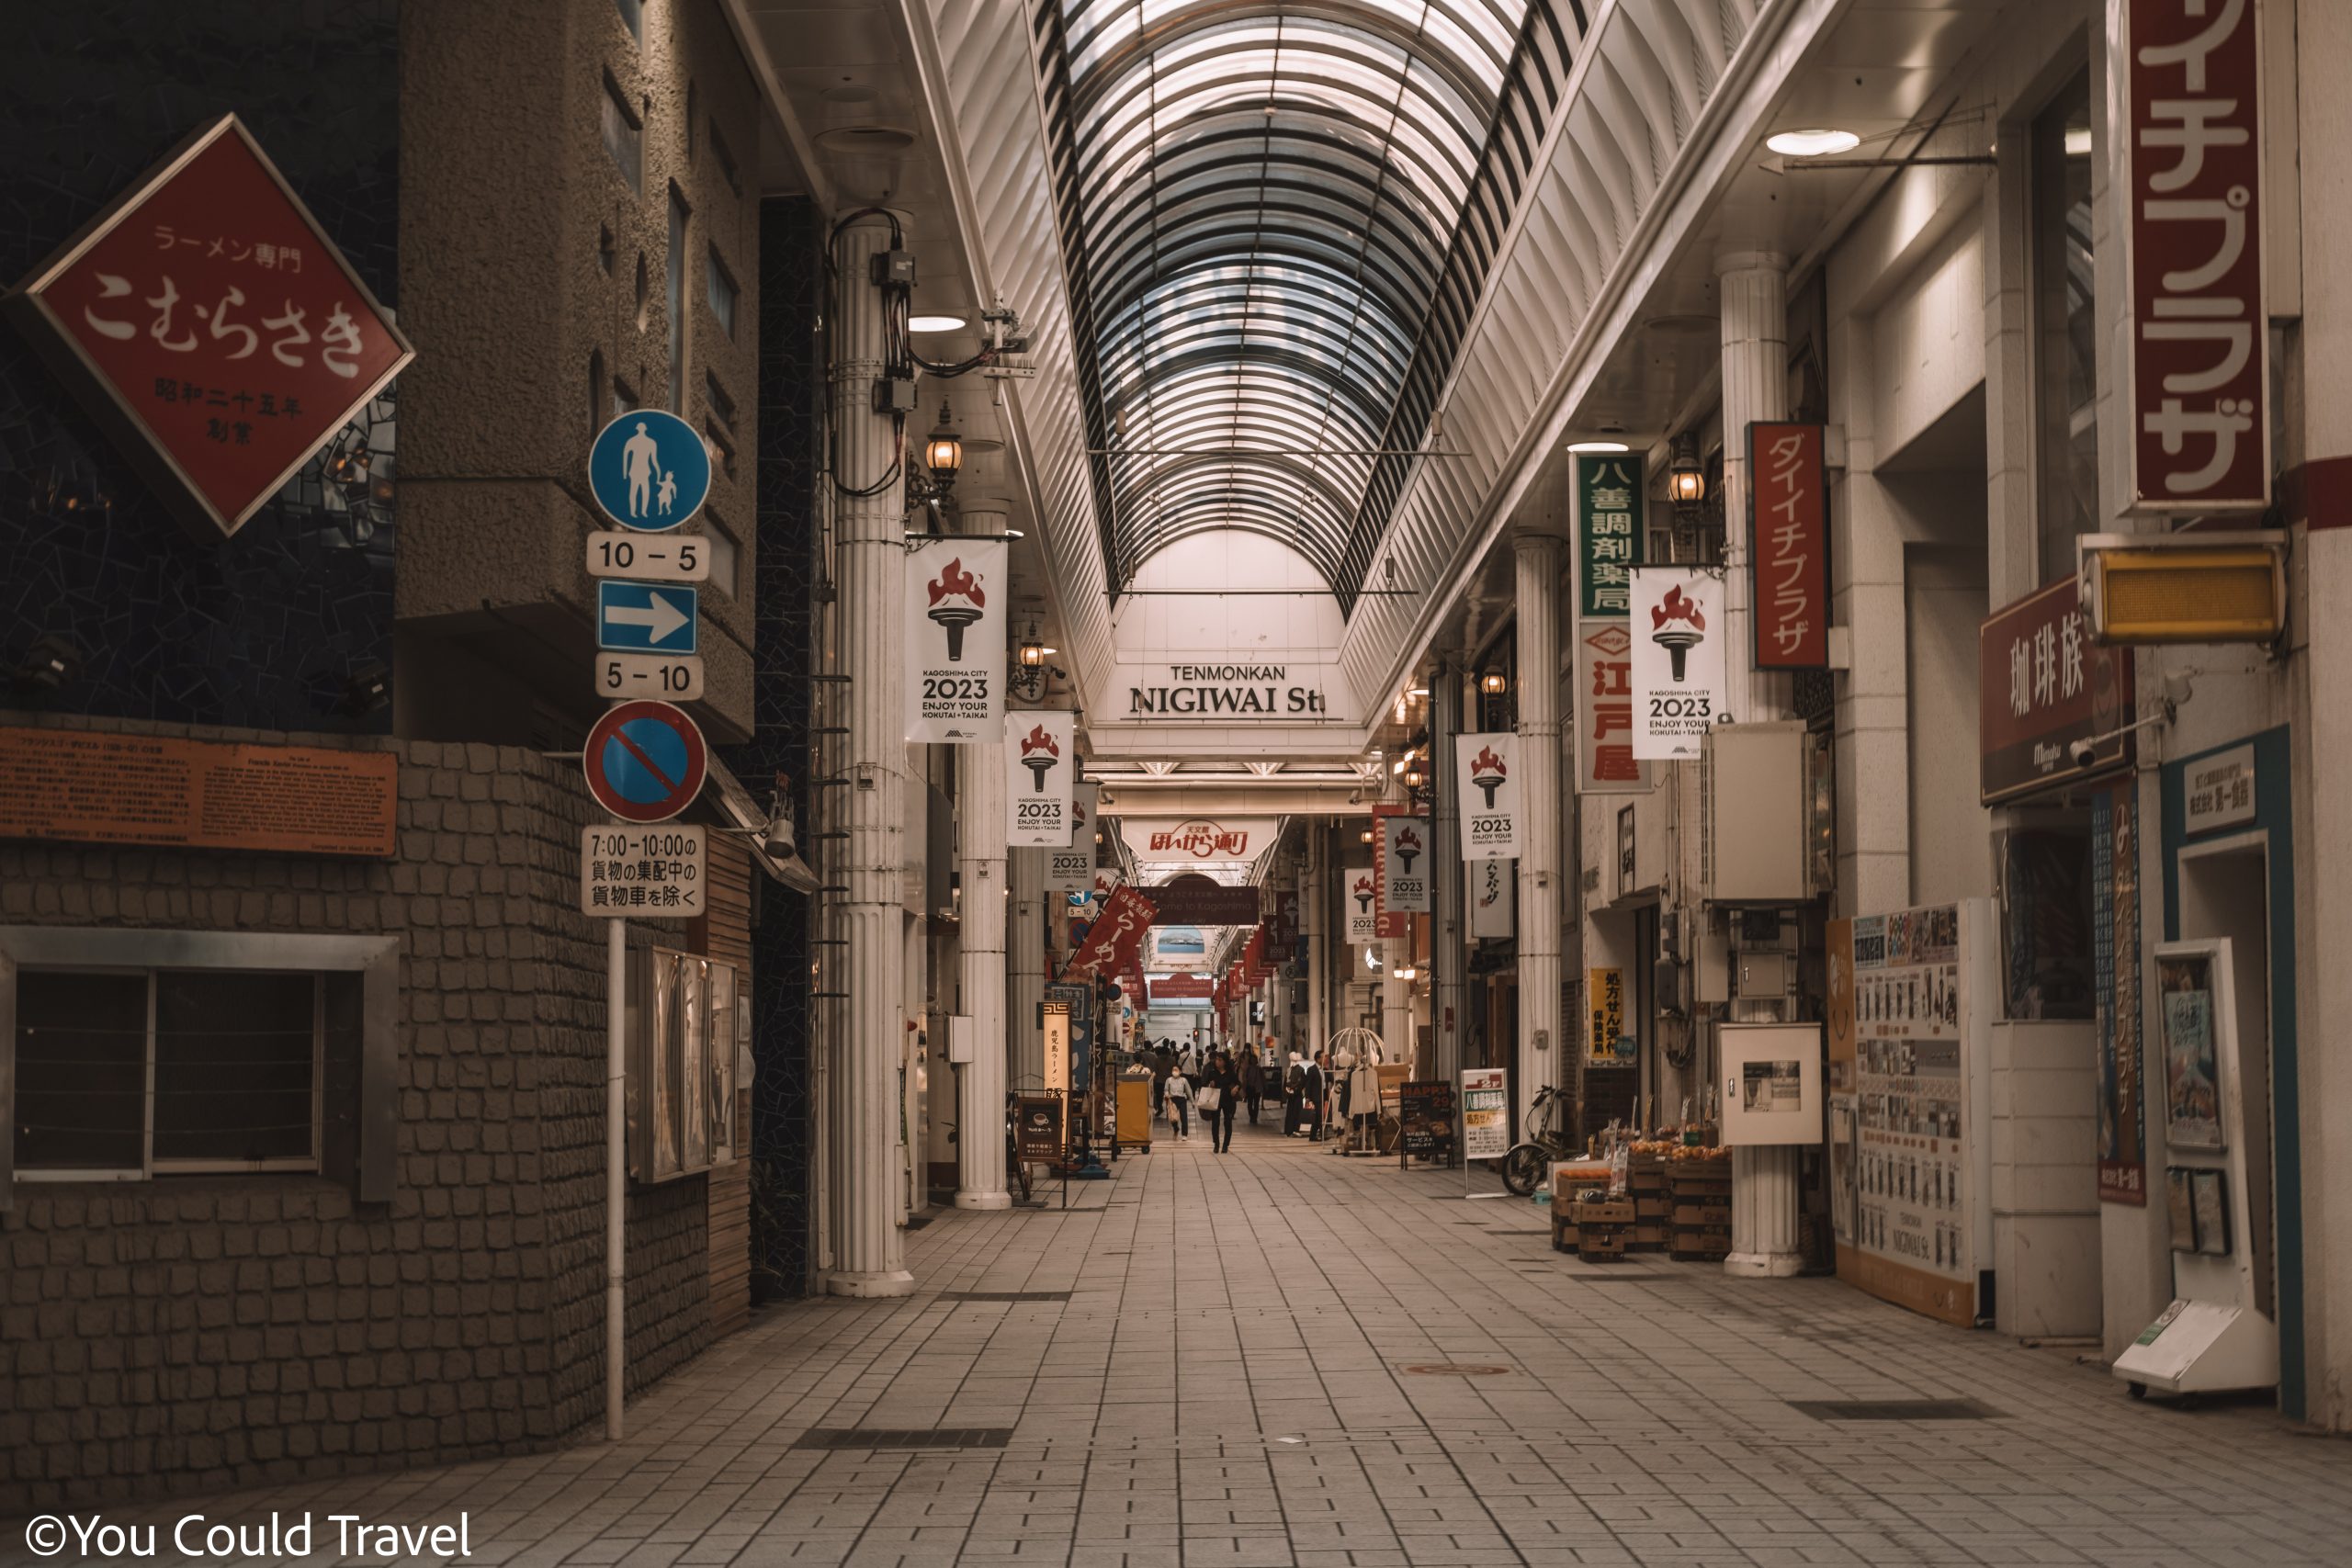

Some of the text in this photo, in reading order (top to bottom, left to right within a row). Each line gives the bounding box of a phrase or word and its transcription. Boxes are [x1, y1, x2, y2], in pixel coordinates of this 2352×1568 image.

[154, 225, 301, 274] ラーメン専門
[85, 272, 364, 379] こむらさき
[154, 378, 303, 420] 昭和二十五年
[206, 418, 254, 446] 創業
[1590, 462, 1633, 611] 八善調剤薬局
[1769, 433, 1809, 656] ダイイチプラザ
[599, 541, 634, 569] 10
[679, 545, 696, 571] 5
[607, 662, 622, 688] 5
[660, 665, 690, 692] 10
[1170, 666, 1285, 681] TENMONKAN
[2009, 611, 2084, 719] 珈琲族
[922, 679, 988, 699] 2023
[1129, 687, 1277, 713] NIGIWAI
[922, 702, 988, 710] ENJOY YOUR
[1650, 698, 1711, 716] 2023
[1593, 660, 1640, 781] 江戸屋
[1018, 804, 1061, 818] 2023
[1472, 819, 1512, 833] 2023
[1149, 832, 1249, 857] はいから通り
[592, 860, 696, 882] 貨物の集配中の
[1053, 858, 1088, 868] 2023
[592, 886, 695, 908] 貨物車を除く
[1393, 882, 1423, 892] 2023
[1605, 972, 1621, 1054] 処方せん受付
[1051, 1030, 1059, 1083] 鹿児島ラーメン
[1403, 1086, 1449, 1096] HAPPY
[1432, 1096, 1450, 1107] 29
